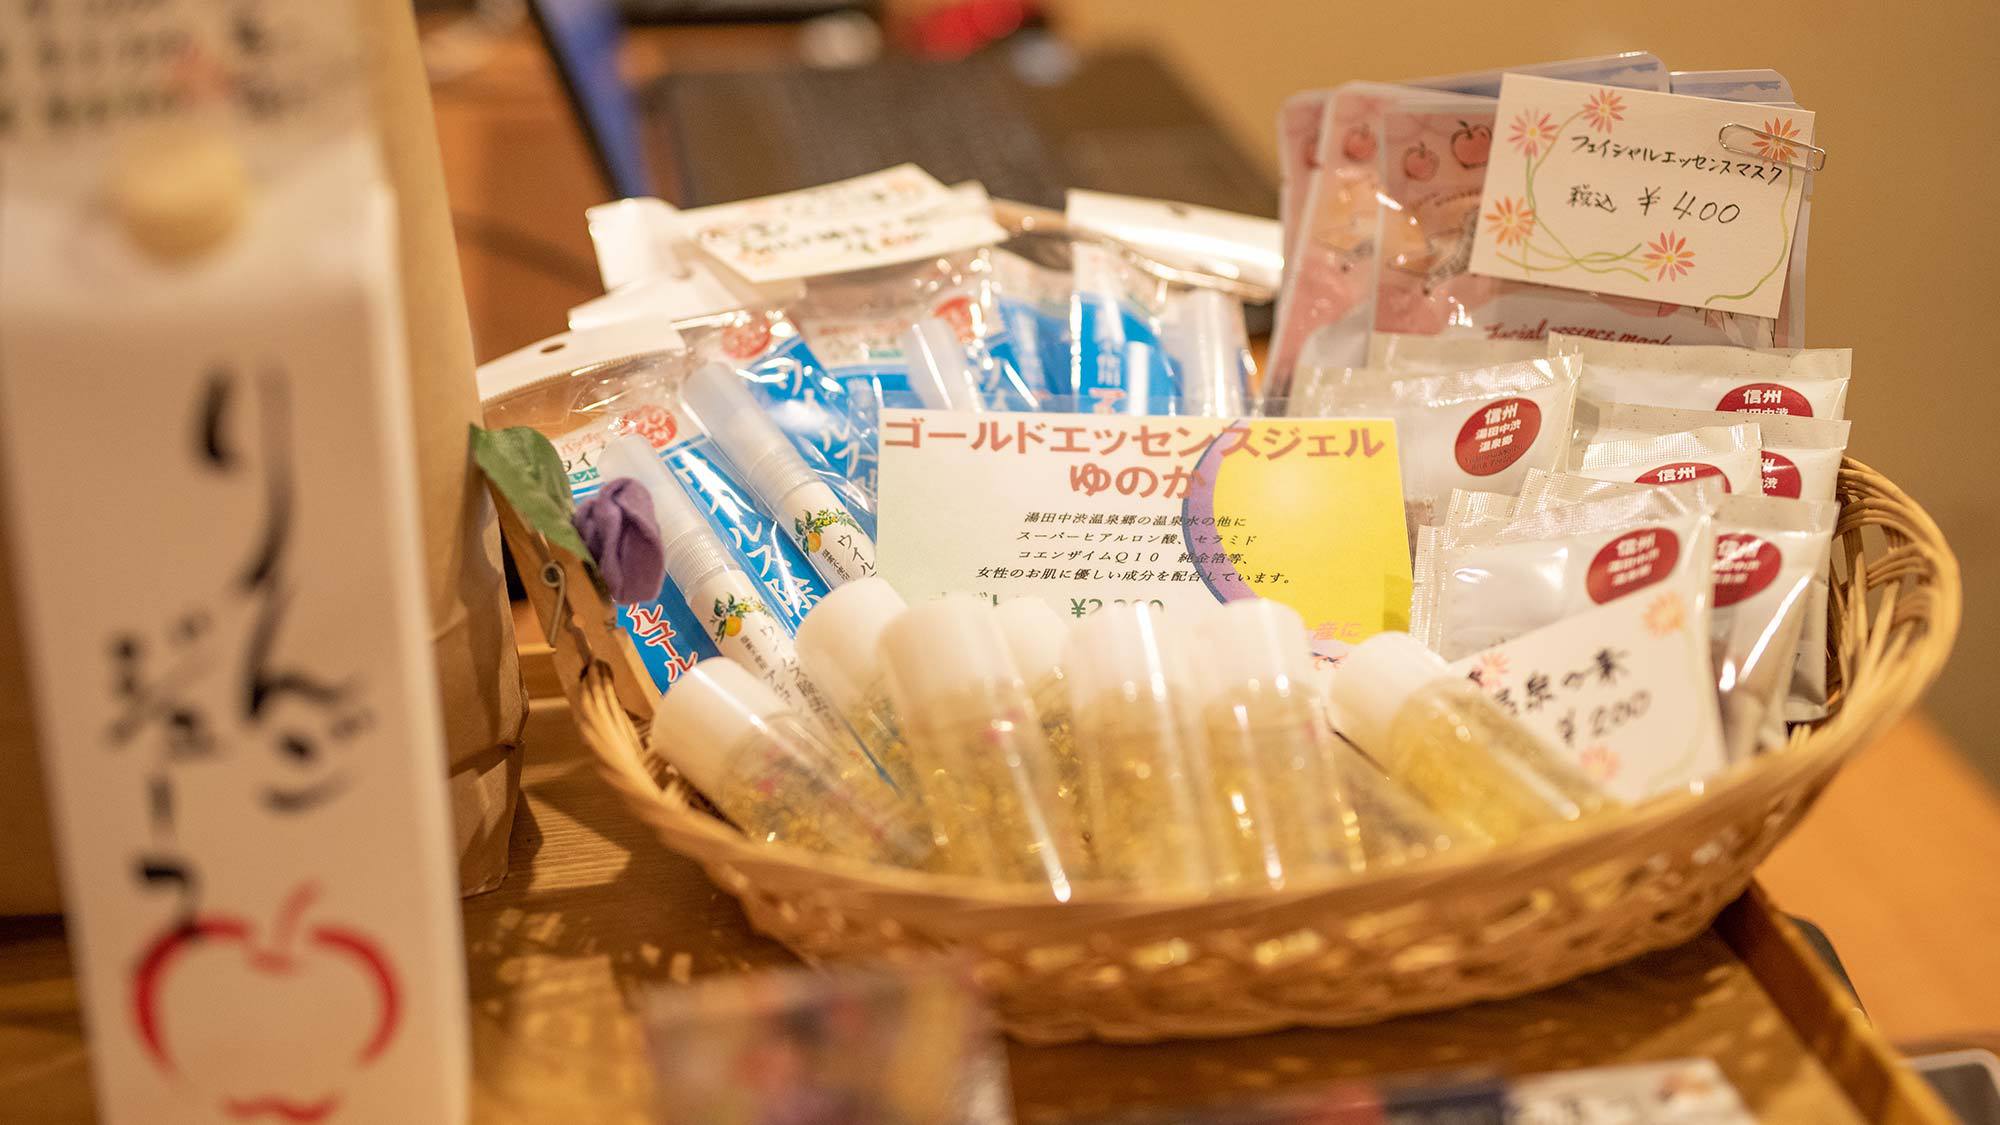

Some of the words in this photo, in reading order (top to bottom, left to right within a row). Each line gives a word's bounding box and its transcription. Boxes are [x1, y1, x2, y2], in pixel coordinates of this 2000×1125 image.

[1571, 135, 1783, 185] フェイシャルエッセンスマスク
[1569, 184, 1617, 213] 税込
[1742, 389, 1782, 405] 信州
[1485, 402, 1519, 425] 信州
[884, 418, 1385, 460] ゴールドエッセンスジェル
[1070, 462, 1206, 500] ゆのか
[1657, 466, 1696, 482] 信州
[1023, 511, 1247, 528] 湯田中渋温泉郷の温泉水の他に
[976, 567, 1292, 585] 女性のお肌に優しい成分を配合しています。
